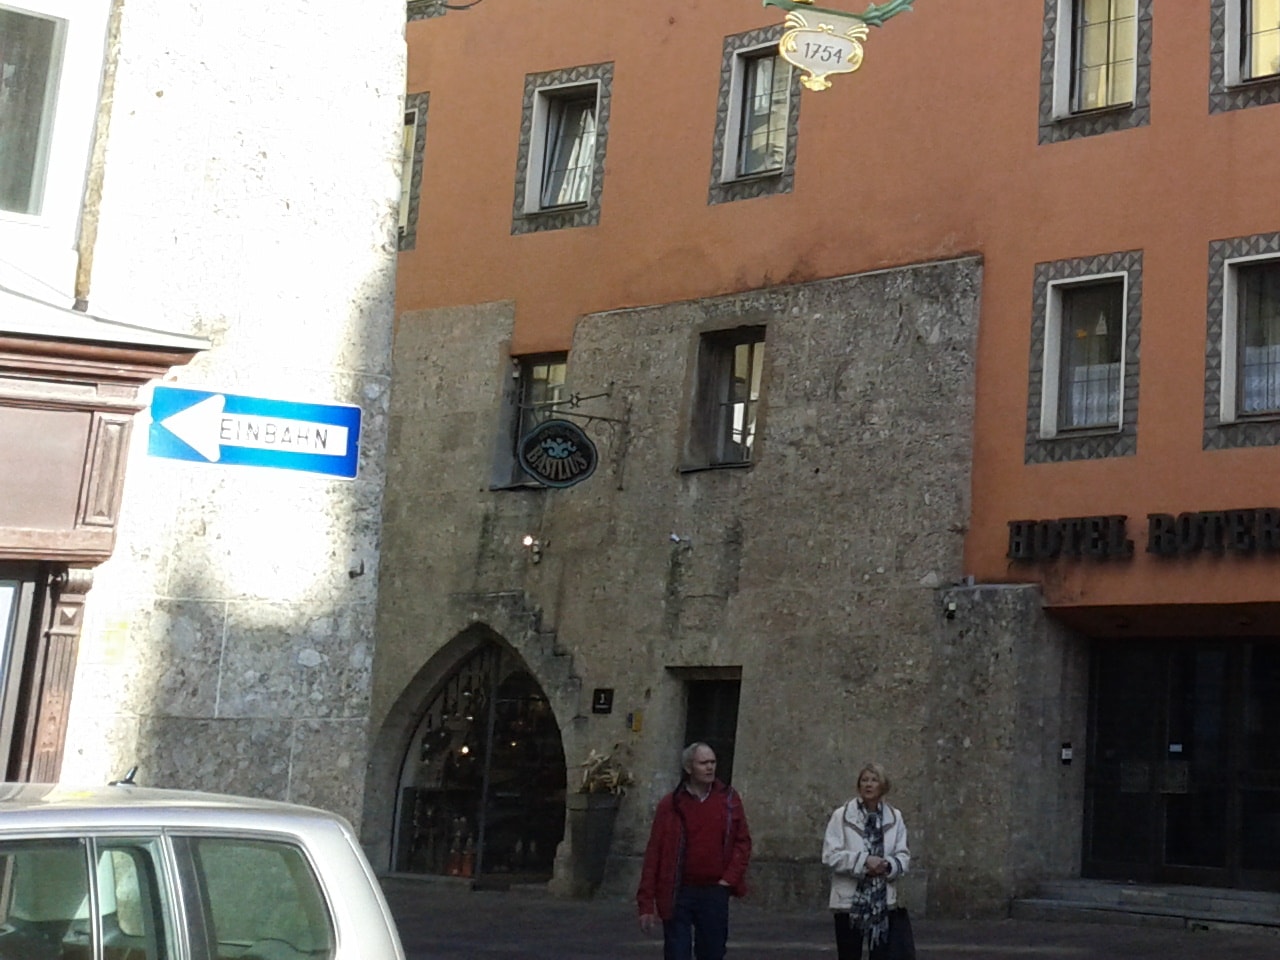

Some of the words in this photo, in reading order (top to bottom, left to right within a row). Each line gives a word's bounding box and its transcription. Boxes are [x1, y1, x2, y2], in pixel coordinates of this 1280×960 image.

[804, 42, 842, 64] 1754
[219, 418, 328, 449] EINBAHN
[526, 445, 588, 480] BASILIUS
[1006, 515, 1134, 559] HOTEL
